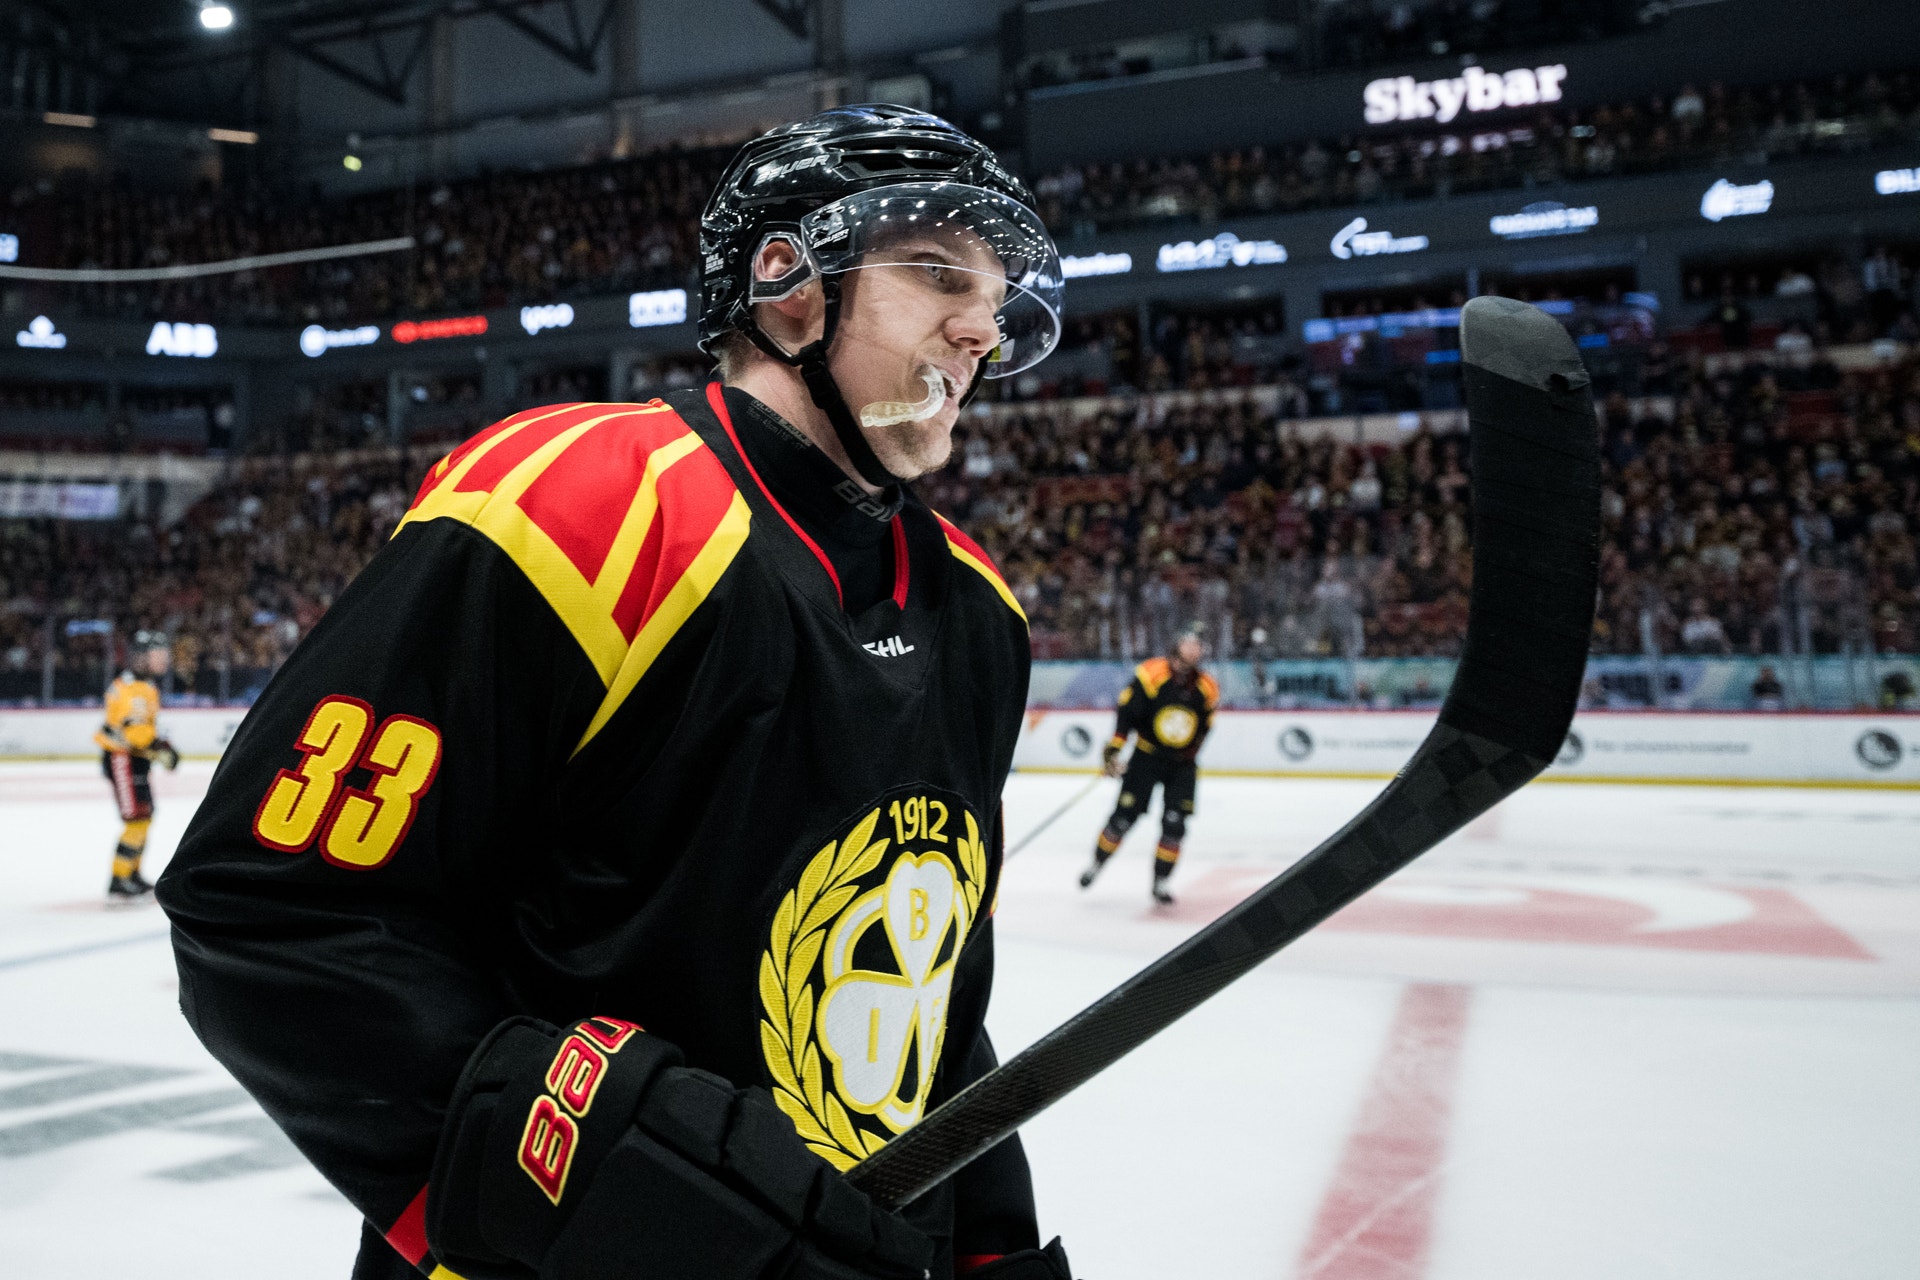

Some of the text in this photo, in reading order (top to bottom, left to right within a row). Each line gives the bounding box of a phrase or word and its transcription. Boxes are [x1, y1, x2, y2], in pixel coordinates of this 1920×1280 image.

[1363, 64, 1567, 124] Skybar
[753, 155, 830, 186] BAUER
[147, 322, 217, 357] ABB
[251, 693, 443, 871] 33
[889, 796, 949, 845] 1912
[909, 887, 929, 941] B
[867, 1007, 880, 1063] I
